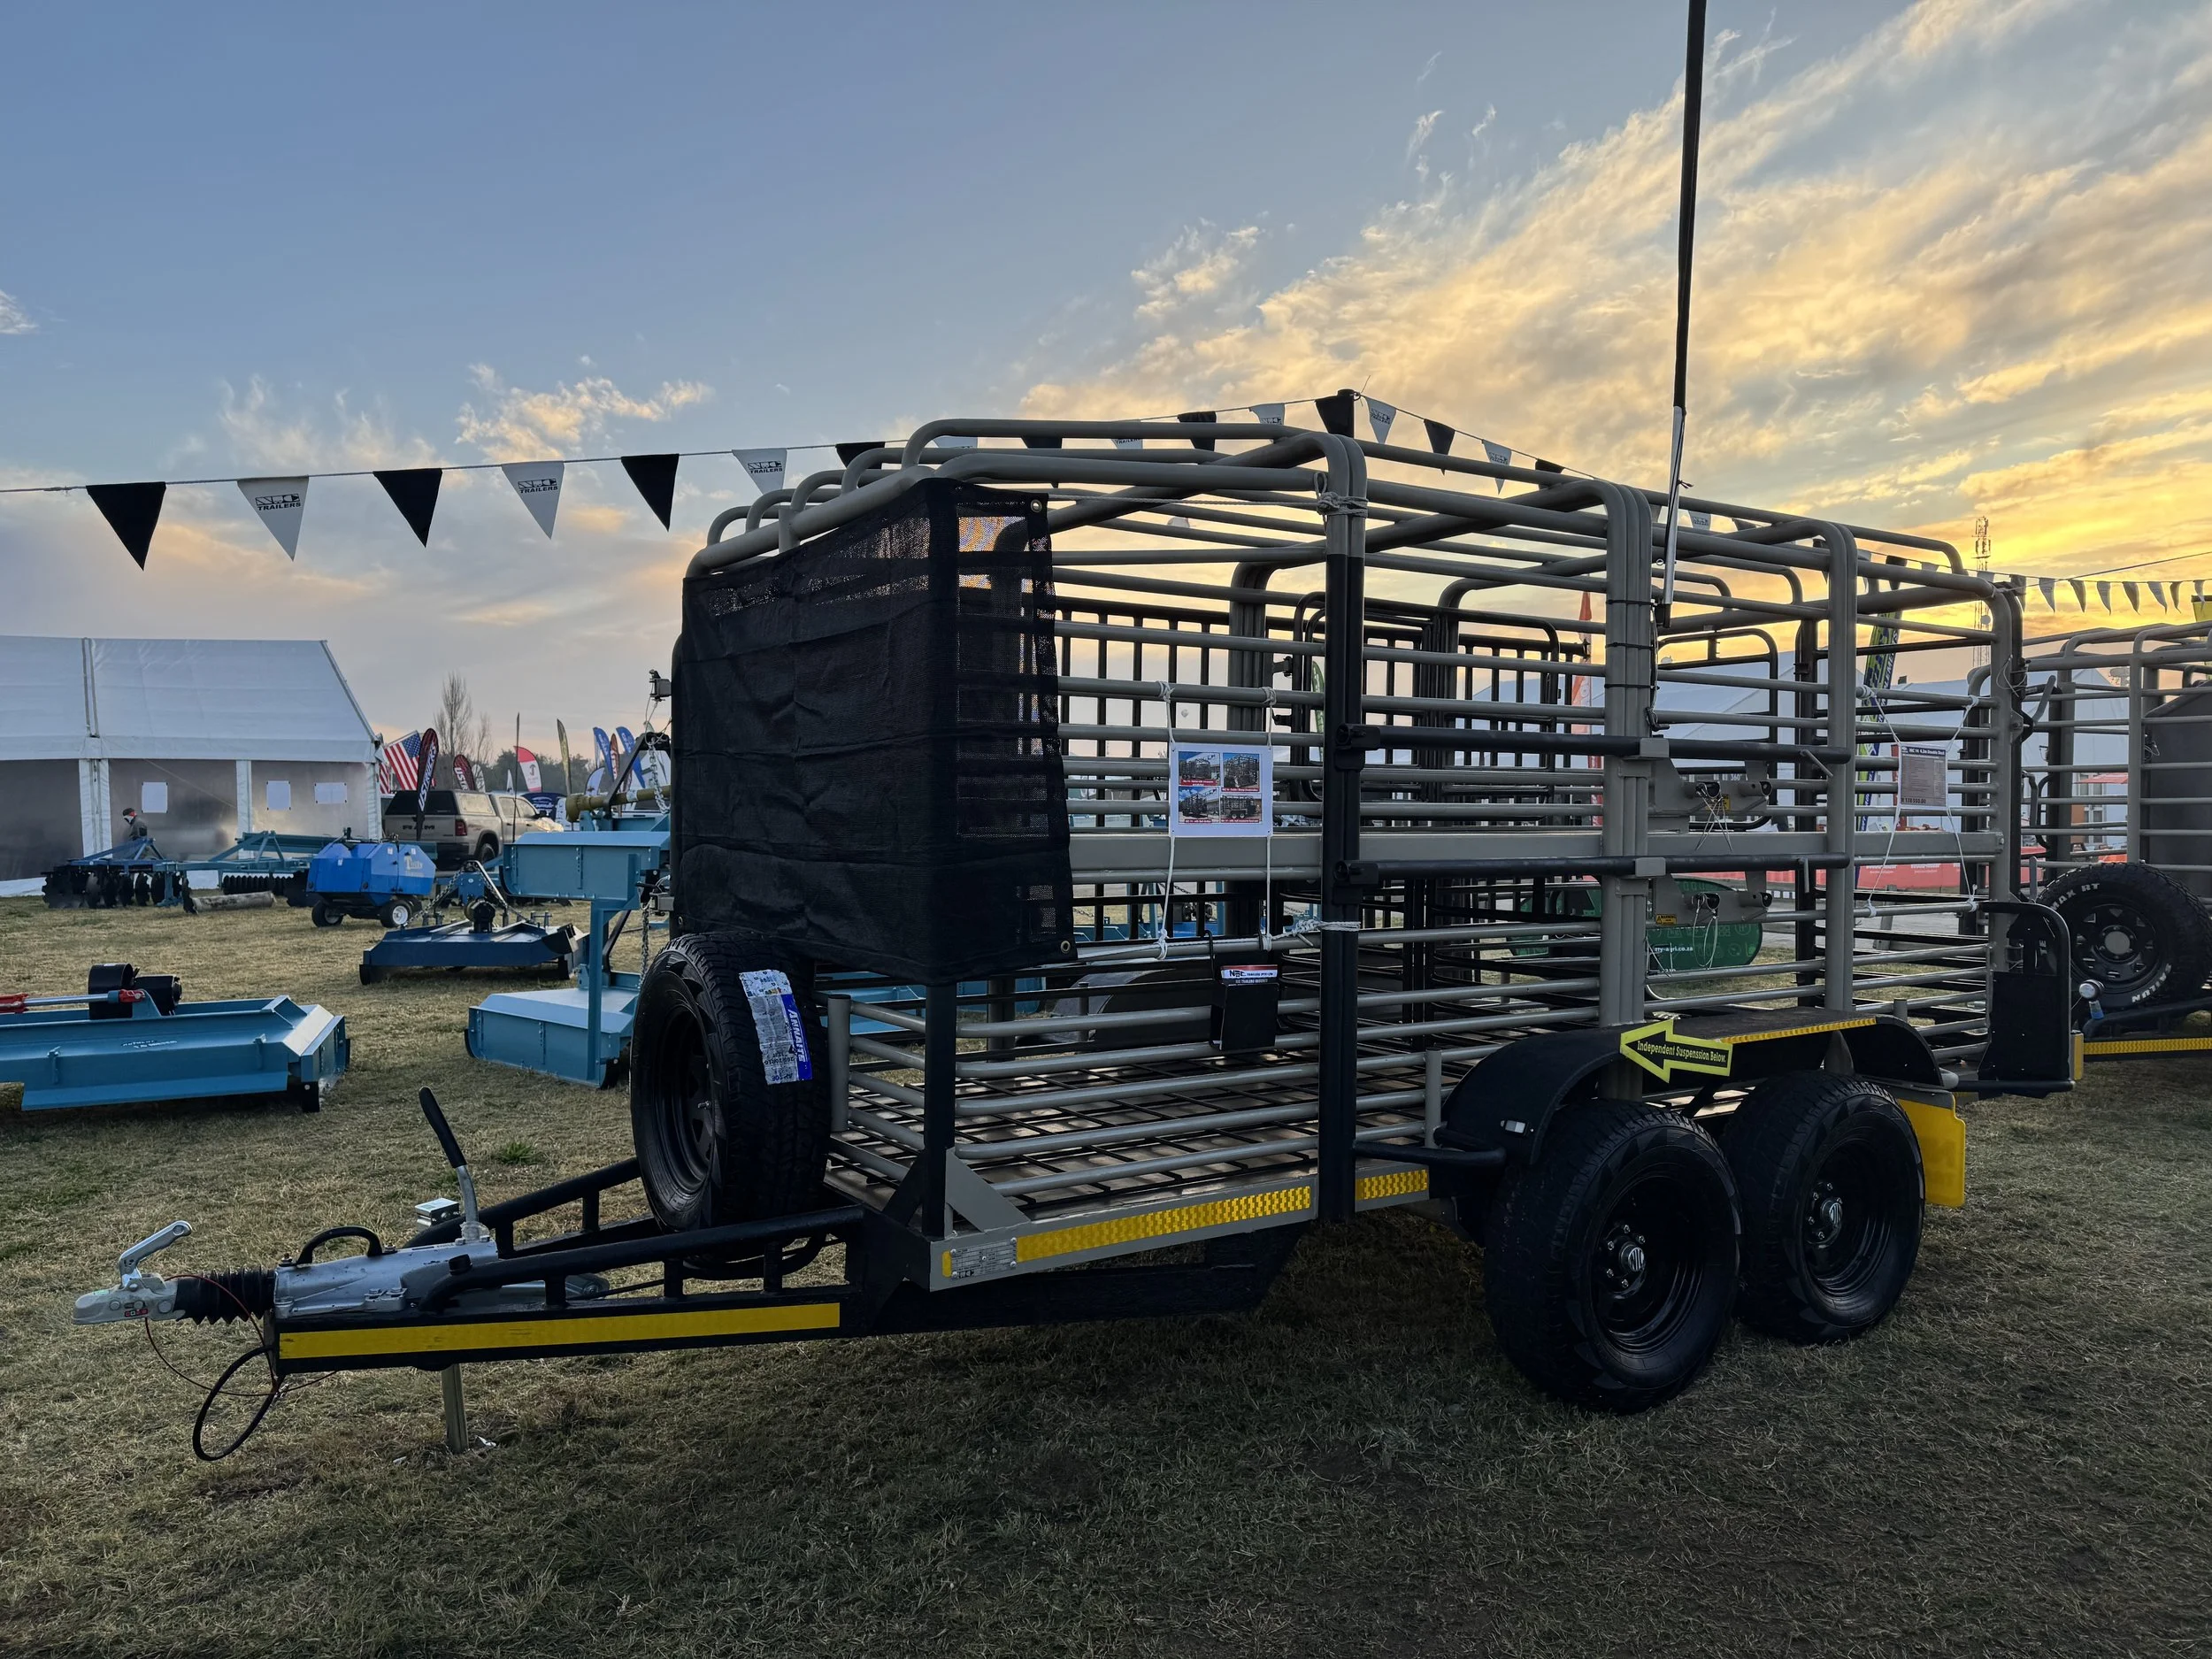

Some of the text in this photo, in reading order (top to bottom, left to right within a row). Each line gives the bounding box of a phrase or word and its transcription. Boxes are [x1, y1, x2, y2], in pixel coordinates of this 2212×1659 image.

[257, 502, 301, 511] TRAILERS
[2081, 883, 2101, 892] RT
[787, 1009, 805, 1063] ANNAITE
[1637, 1040, 1675, 1056] Independent
[1676, 1046, 1709, 1061] Suspenssion
